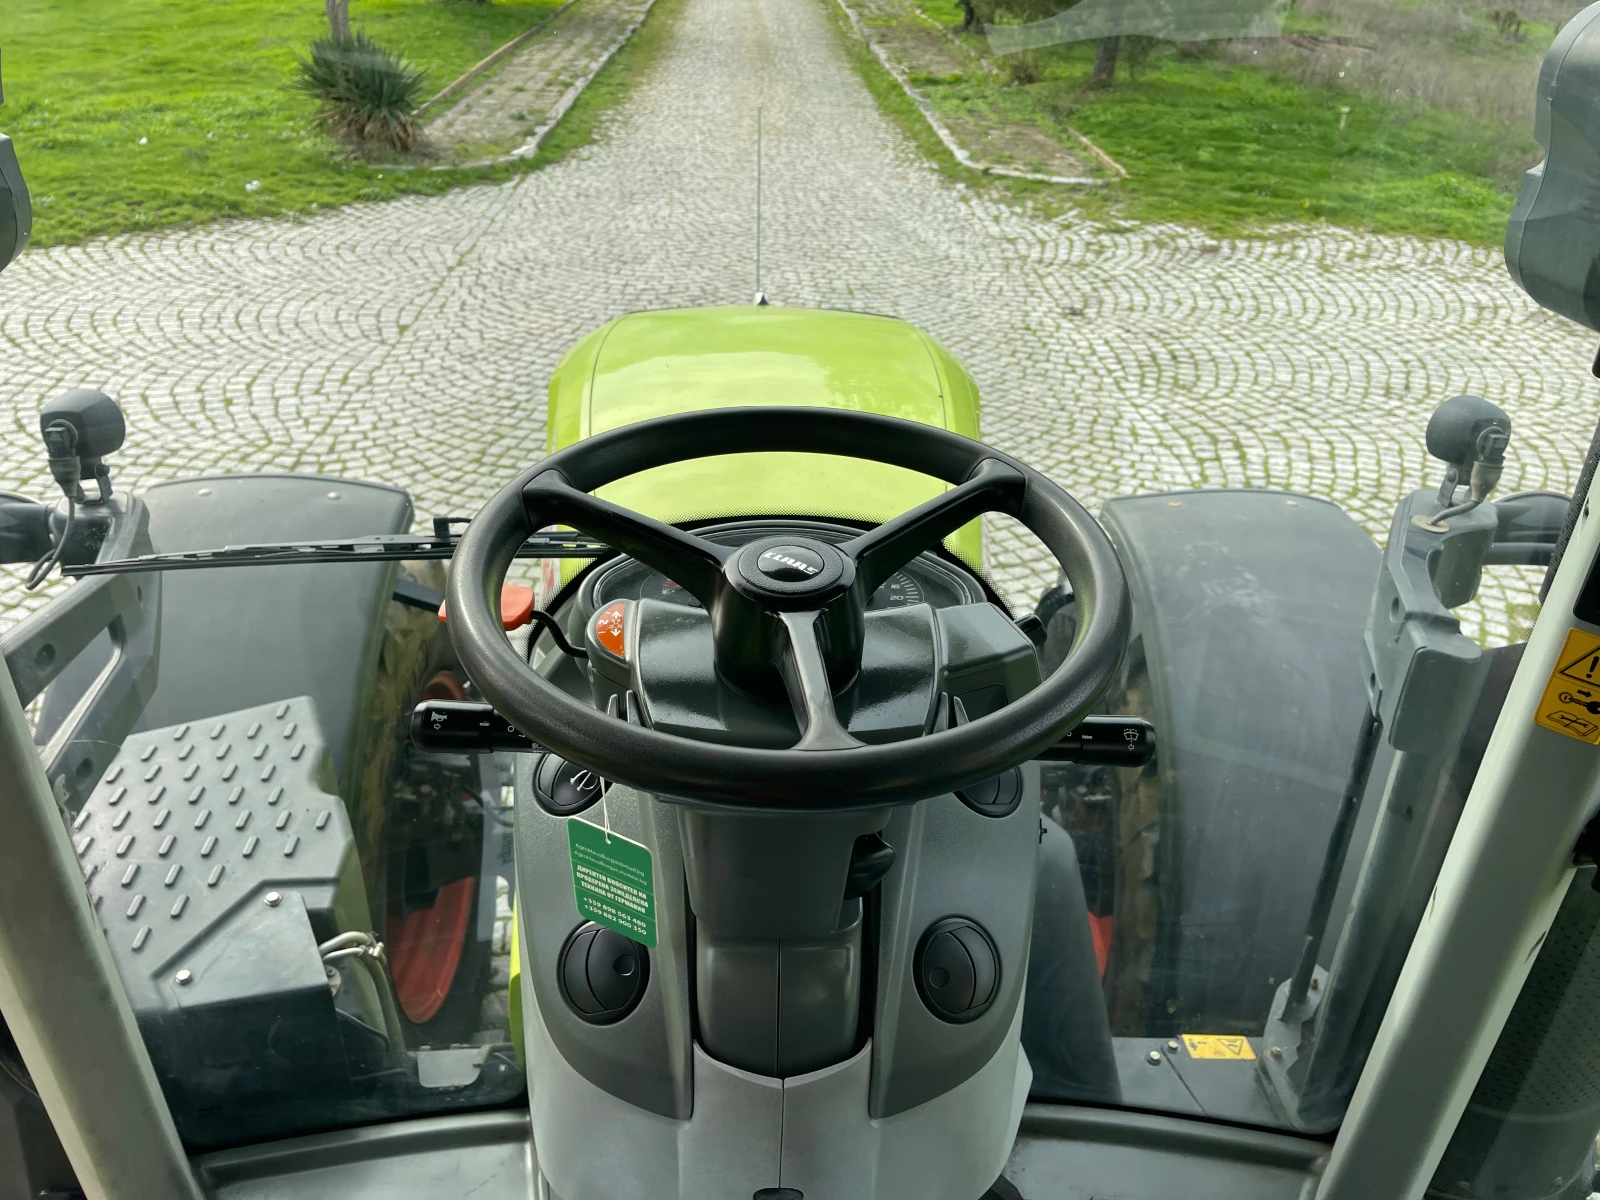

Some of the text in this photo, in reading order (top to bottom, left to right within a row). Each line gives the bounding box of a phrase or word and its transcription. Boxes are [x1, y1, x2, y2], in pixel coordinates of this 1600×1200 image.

[762, 551, 819, 575] CLAAS
[576, 872, 648, 907] ПРОВЕРЕНА ЗЕМЕДЕЛСКА
[577, 865, 647, 899] ДИРЕКТЕН ВНОСИТЕЛ НА
[581, 881, 606, 896] ТЕХНИКА
[615, 896, 645, 913] ГЕРМАНИЯ
[584, 897, 646, 927] +359 898 563 480
[585, 905, 646, 935] +359 882 900 350
